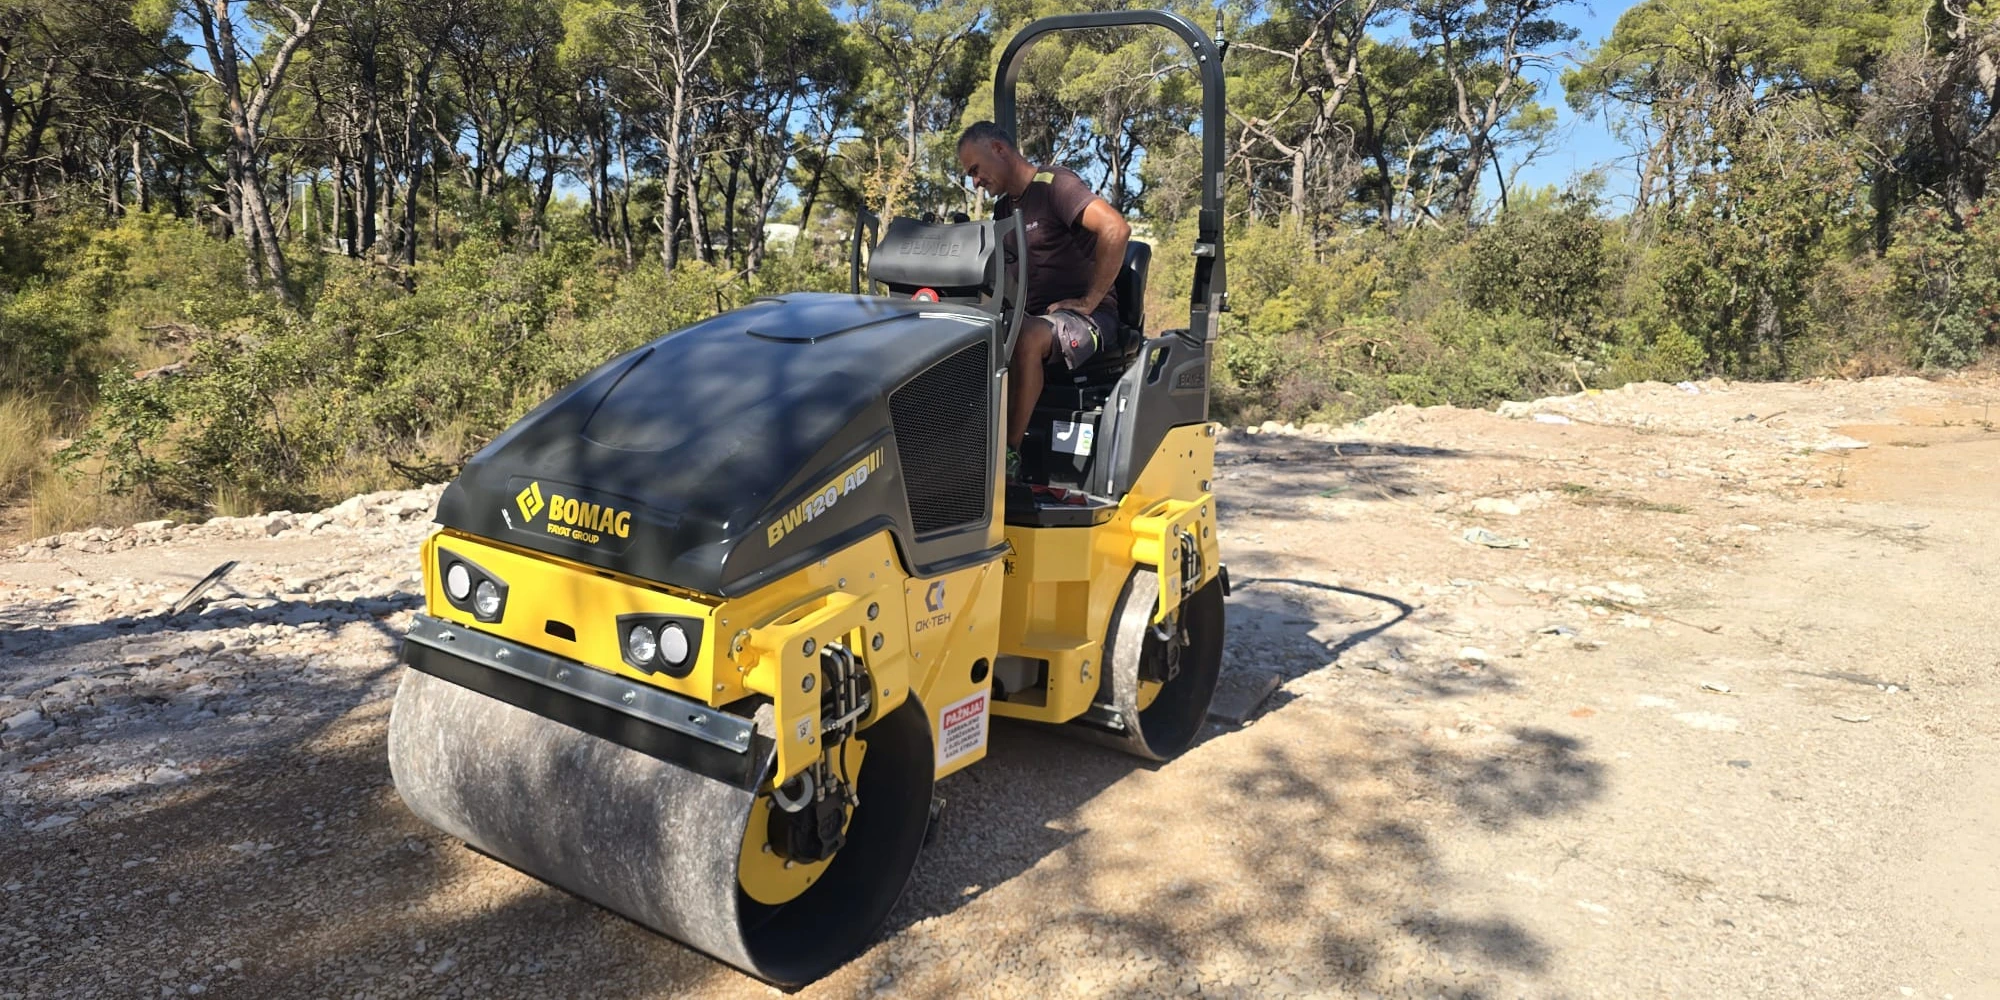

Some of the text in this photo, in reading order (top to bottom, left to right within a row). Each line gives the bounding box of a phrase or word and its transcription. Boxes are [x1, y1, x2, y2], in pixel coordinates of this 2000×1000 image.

[843, 464, 868, 497] AD
[548, 494, 631, 538] BOMAG
[547, 523, 599, 544] FAYAT GROUP
